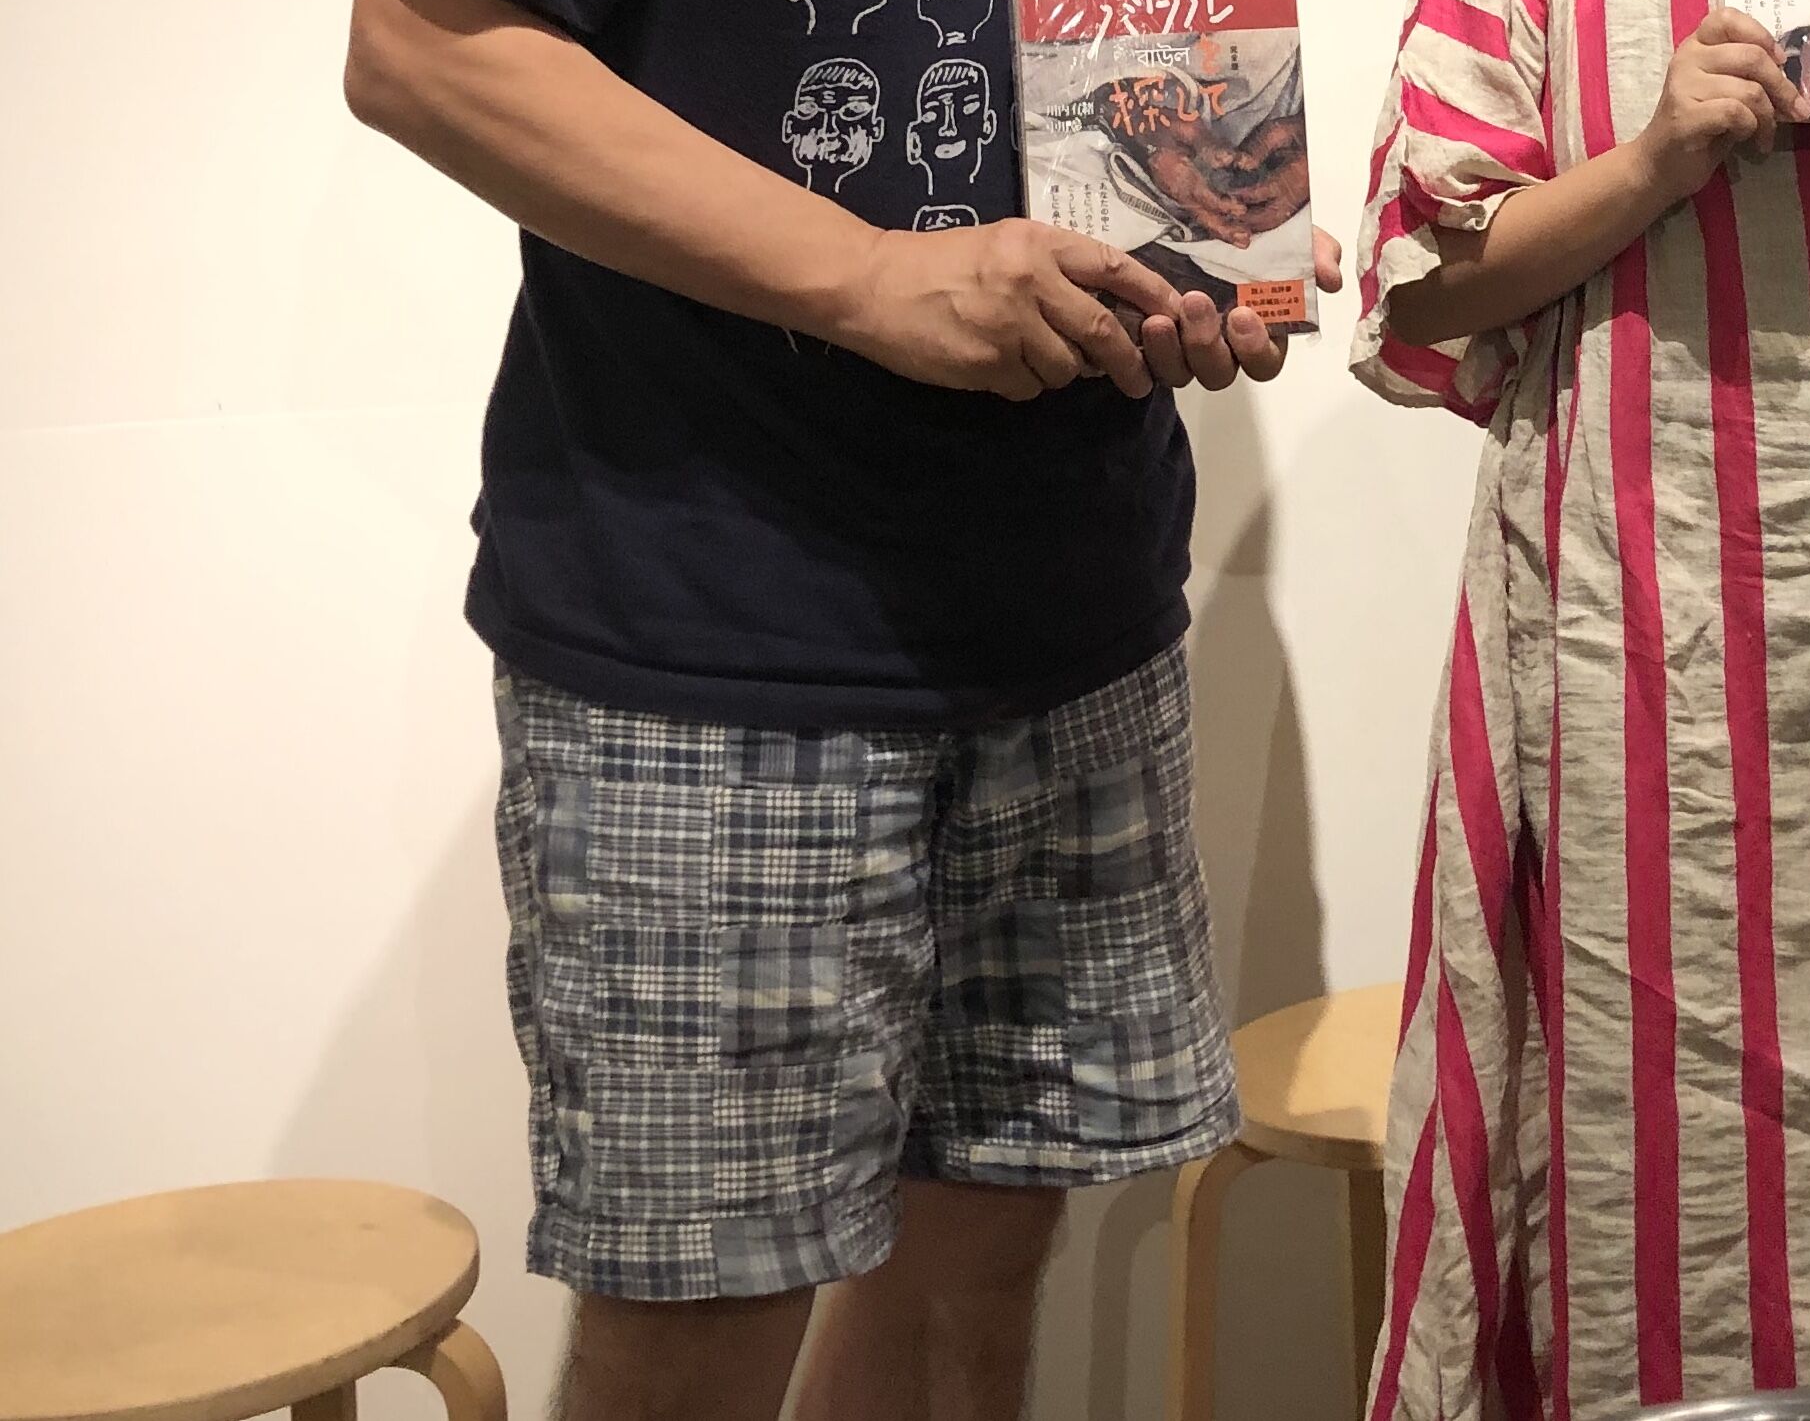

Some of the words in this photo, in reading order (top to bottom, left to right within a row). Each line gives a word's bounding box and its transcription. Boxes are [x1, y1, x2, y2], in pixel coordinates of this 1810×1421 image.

[1135, 43, 1190, 67] বাউল
[1109, 72, 1228, 136] 探して
